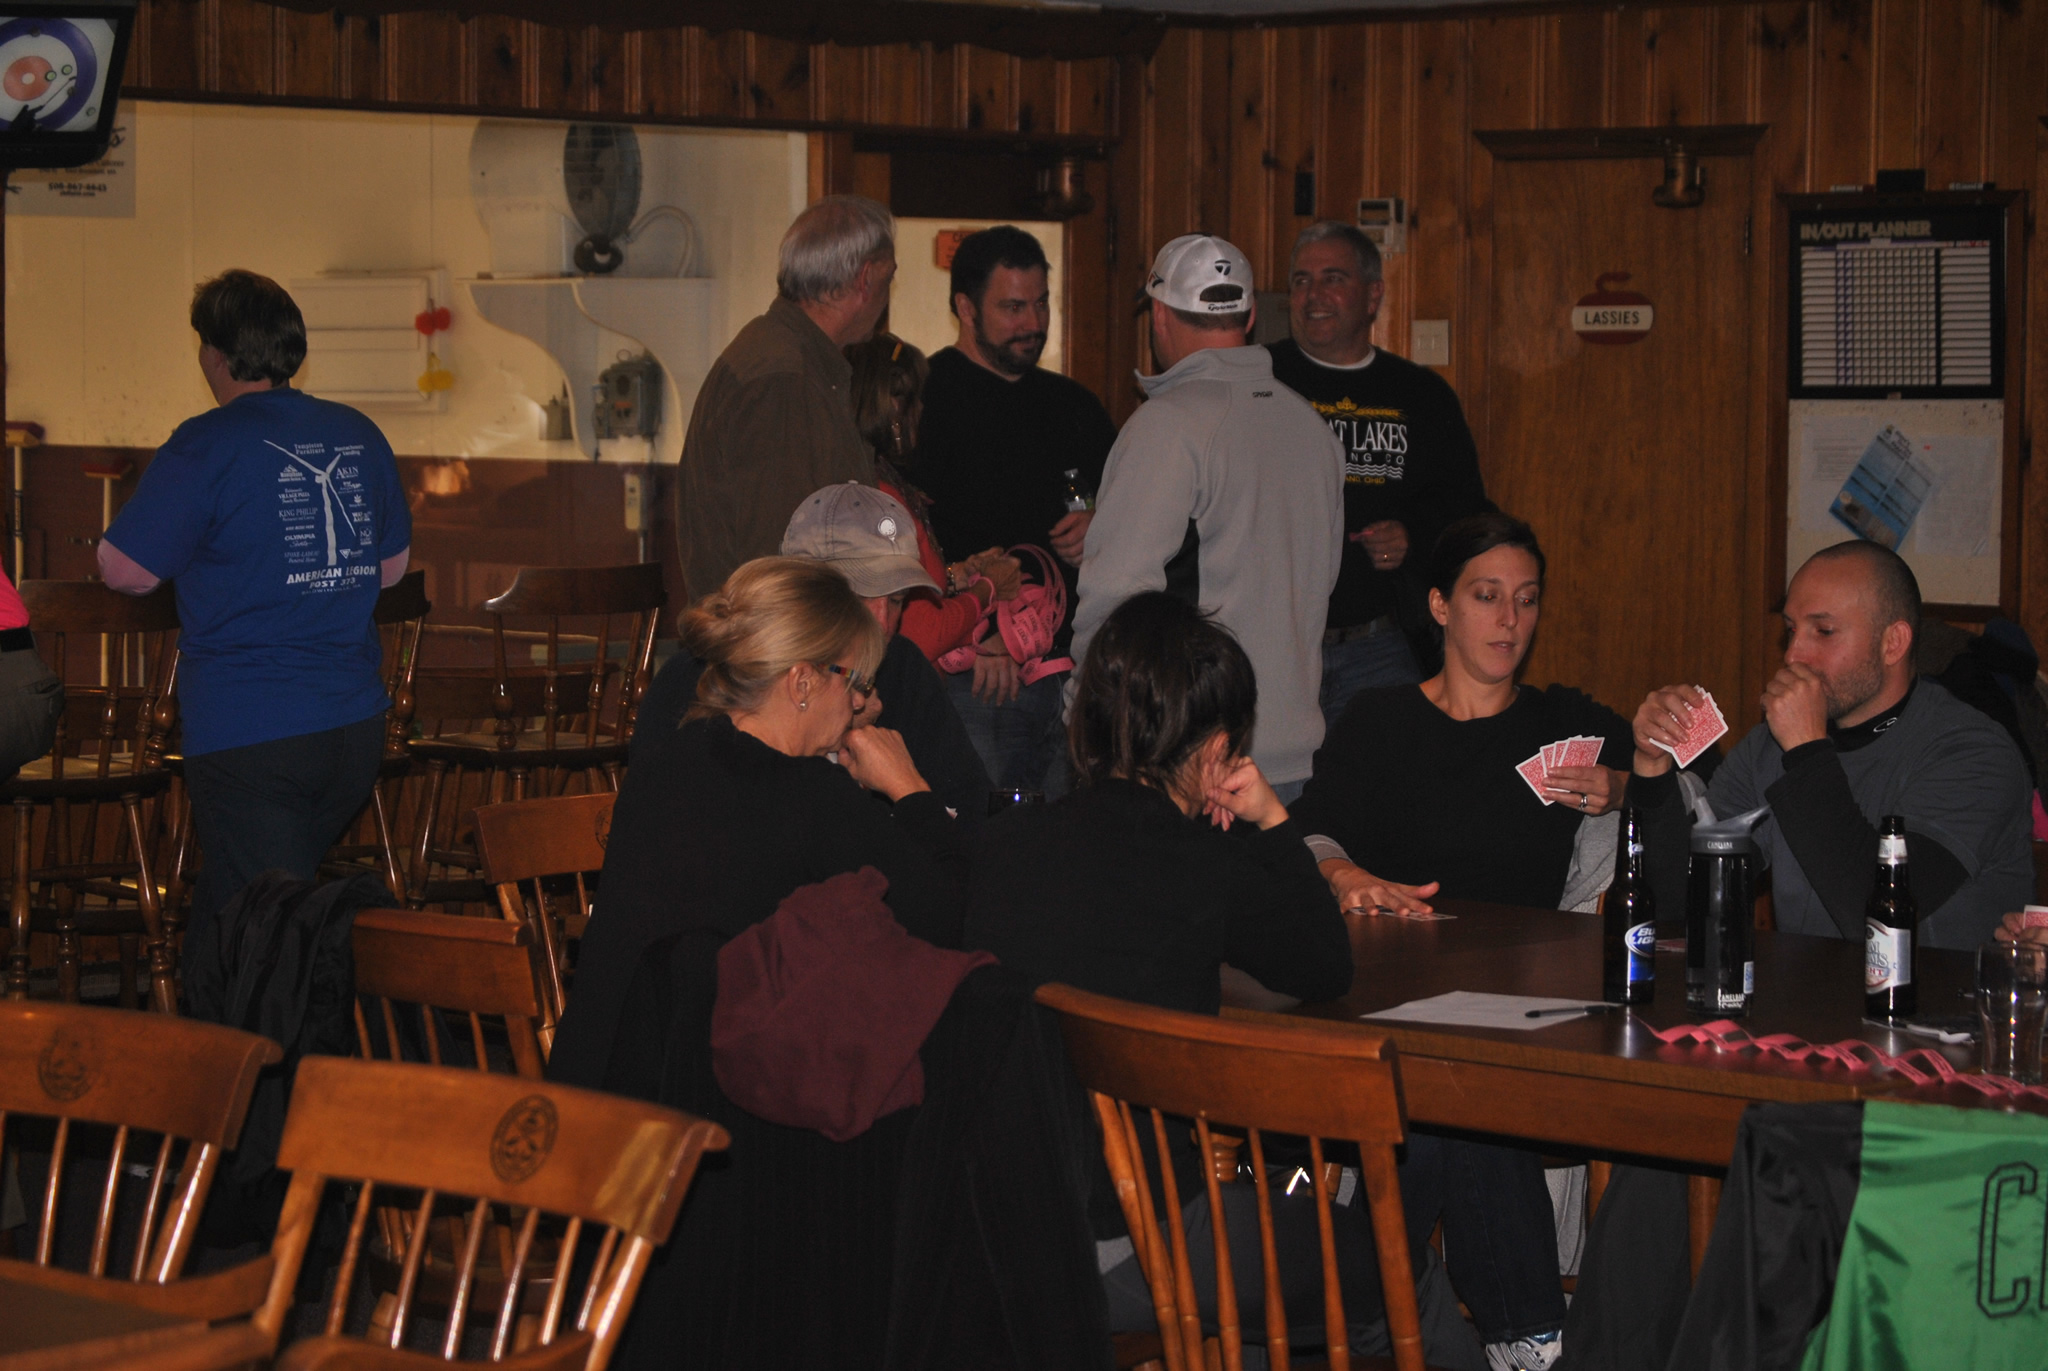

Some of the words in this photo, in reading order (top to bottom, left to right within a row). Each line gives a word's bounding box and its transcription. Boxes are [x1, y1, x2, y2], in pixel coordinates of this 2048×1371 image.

[1800, 220, 1857, 240] IN/OUT
[1858, 219, 1932, 237] PLANNER
[1584, 311, 1640, 324] LASSIES
[1352, 420, 1408, 454] LAKES
[336, 465, 359, 479] AKIN
[1364, 476, 1385, 485] OHIO
[278, 508, 295, 518] KING
[295, 506, 318, 516] PHILLIP
[284, 533, 316, 541] OLYMPIA
[286, 567, 342, 584] AMERICAN
[345, 565, 376, 576] LEGION
[309, 579, 337, 589] POST
[340, 577, 356, 586] 373
[1637, 927, 1656, 937] BU
